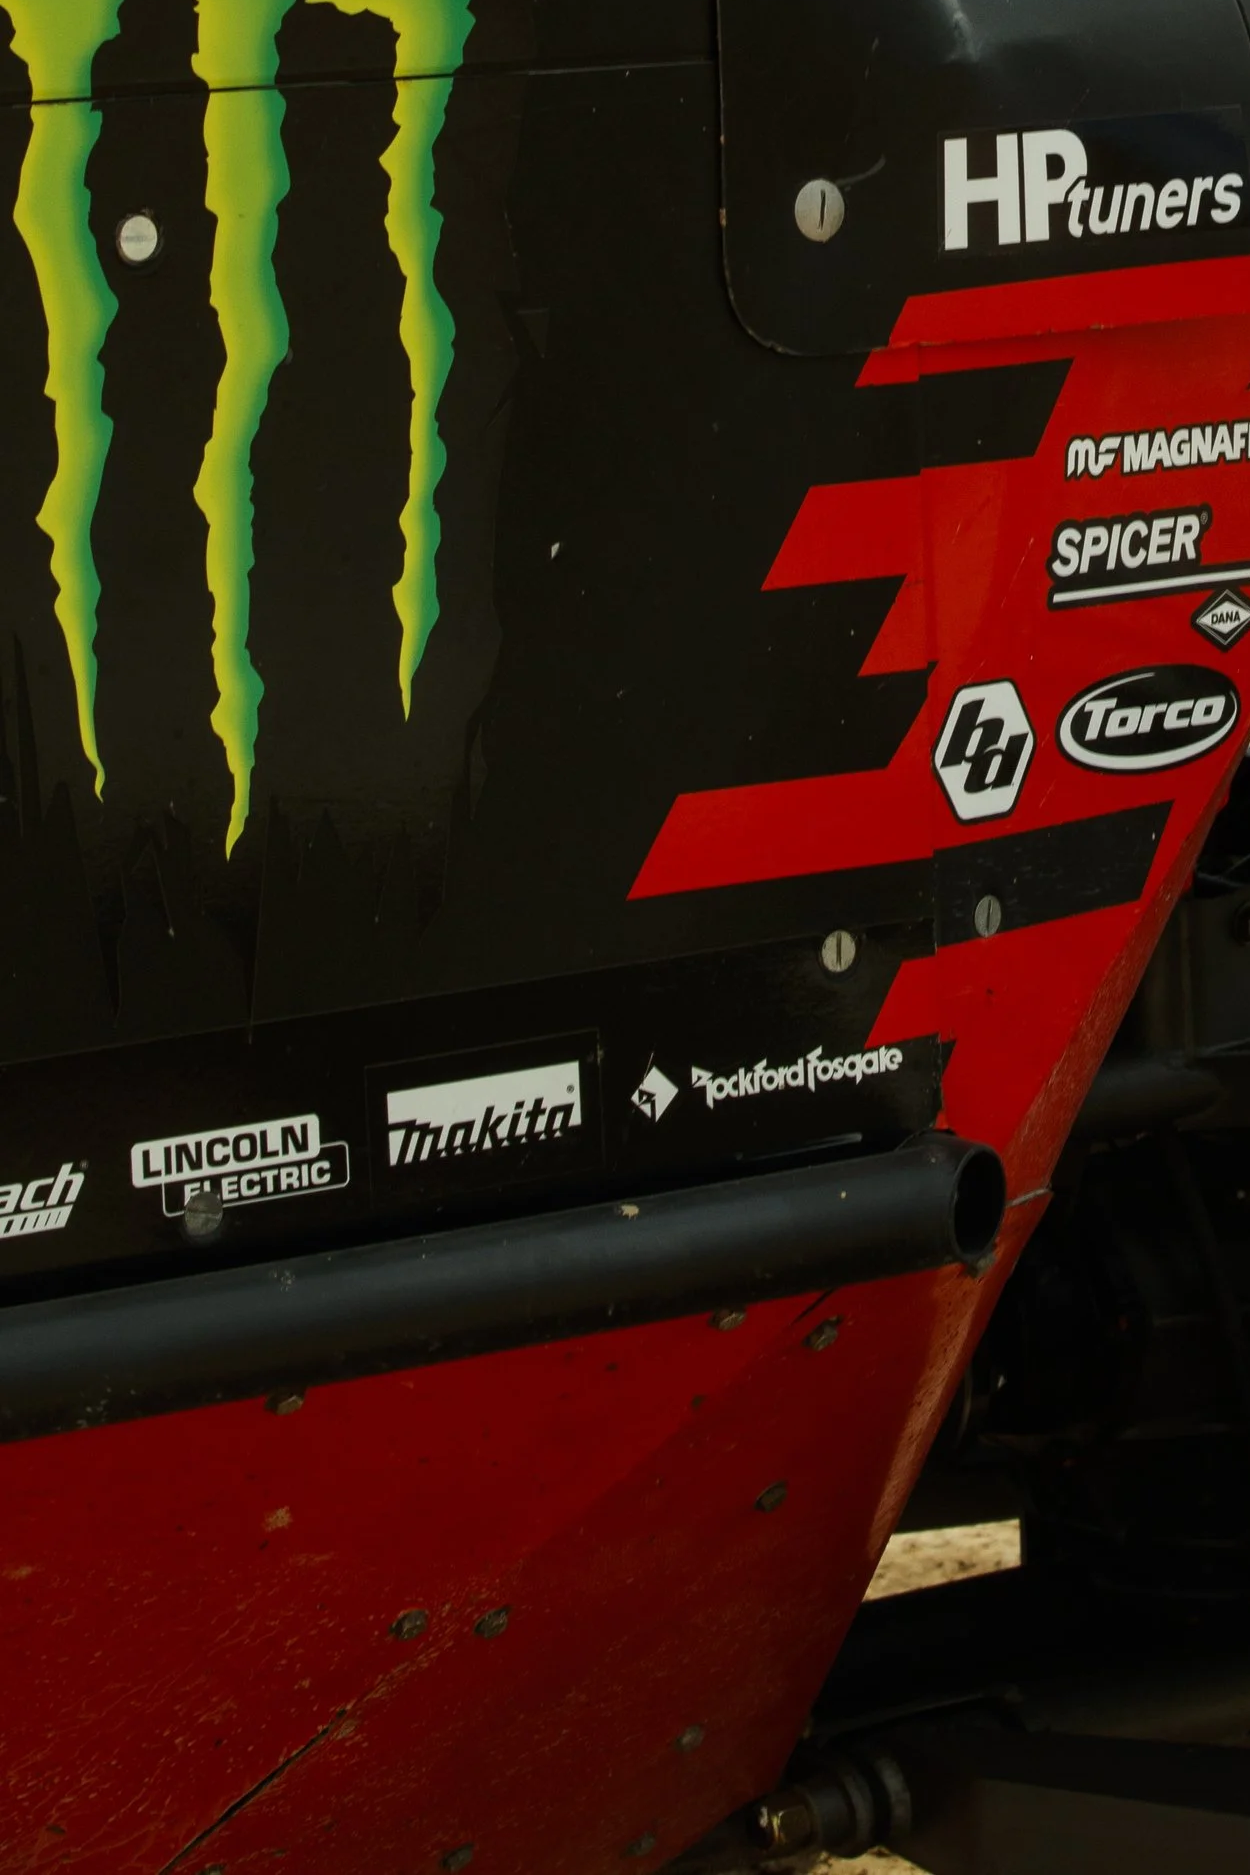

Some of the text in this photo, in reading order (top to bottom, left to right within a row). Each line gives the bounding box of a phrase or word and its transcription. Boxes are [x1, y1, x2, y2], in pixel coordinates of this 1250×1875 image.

[1051, 515, 1201, 577] SPICER
[1210, 610, 1241, 626] DANA
[1082, 691, 1228, 741] Torco
[142, 1122, 309, 1180] LINCOLN
